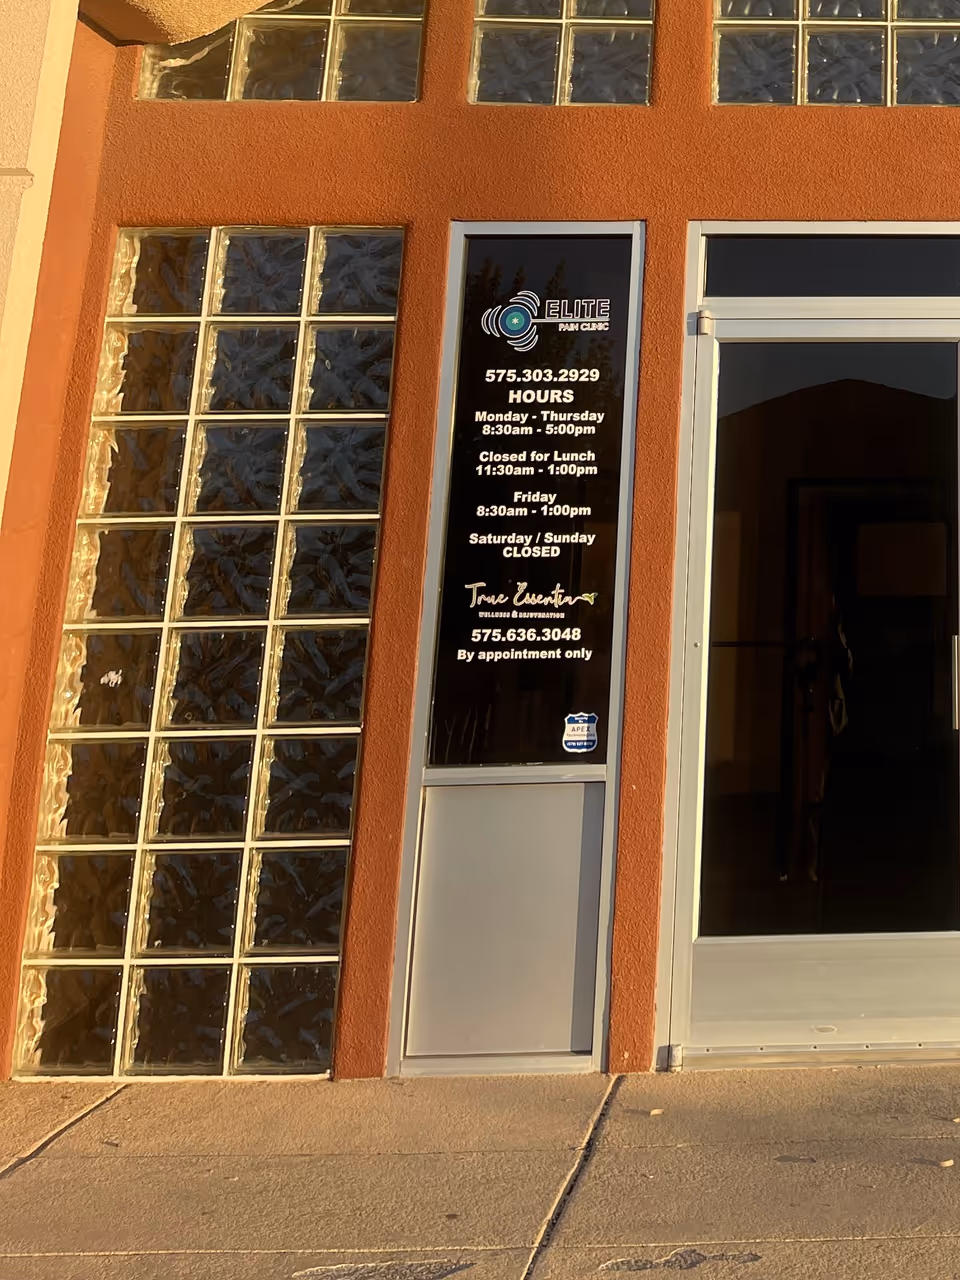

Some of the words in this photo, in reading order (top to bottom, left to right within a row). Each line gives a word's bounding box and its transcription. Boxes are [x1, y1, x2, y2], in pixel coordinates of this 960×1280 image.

[545, 299, 610, 319] ELITE
[559, 323, 579, 332] PAIN
[580, 322, 610, 331] CLINIC
[485, 369, 600, 382] 575.303.2929
[508, 389, 574, 403] HOURS
[474, 411, 529, 424] Monday
[540, 410, 605, 423] Thursday
[482, 424, 533, 435] 8:30am
[545, 423, 596, 437] 5:00pm
[479, 451, 527, 462] Closed
[530, 451, 550, 461] for
[553, 450, 595, 461] Lunch
[475, 464, 535, 476] 11:30am
[547, 464, 598, 477] 1:00pm
[513, 491, 557, 505] Friday
[476, 505, 528, 517] 8:30am
[540, 504, 591, 518] 1:00pm
[469, 533, 533, 546] Saturday
[535, 532, 541, 544] /
[543, 532, 596, 545] Sunday
[502, 546, 561, 558] CLOSED
[464, 582, 509, 608] True
[471, 627, 581, 642] 575.636.3048
[457, 649, 475, 662] By
[477, 648, 561, 662] appointment
[564, 647, 593, 661] only
